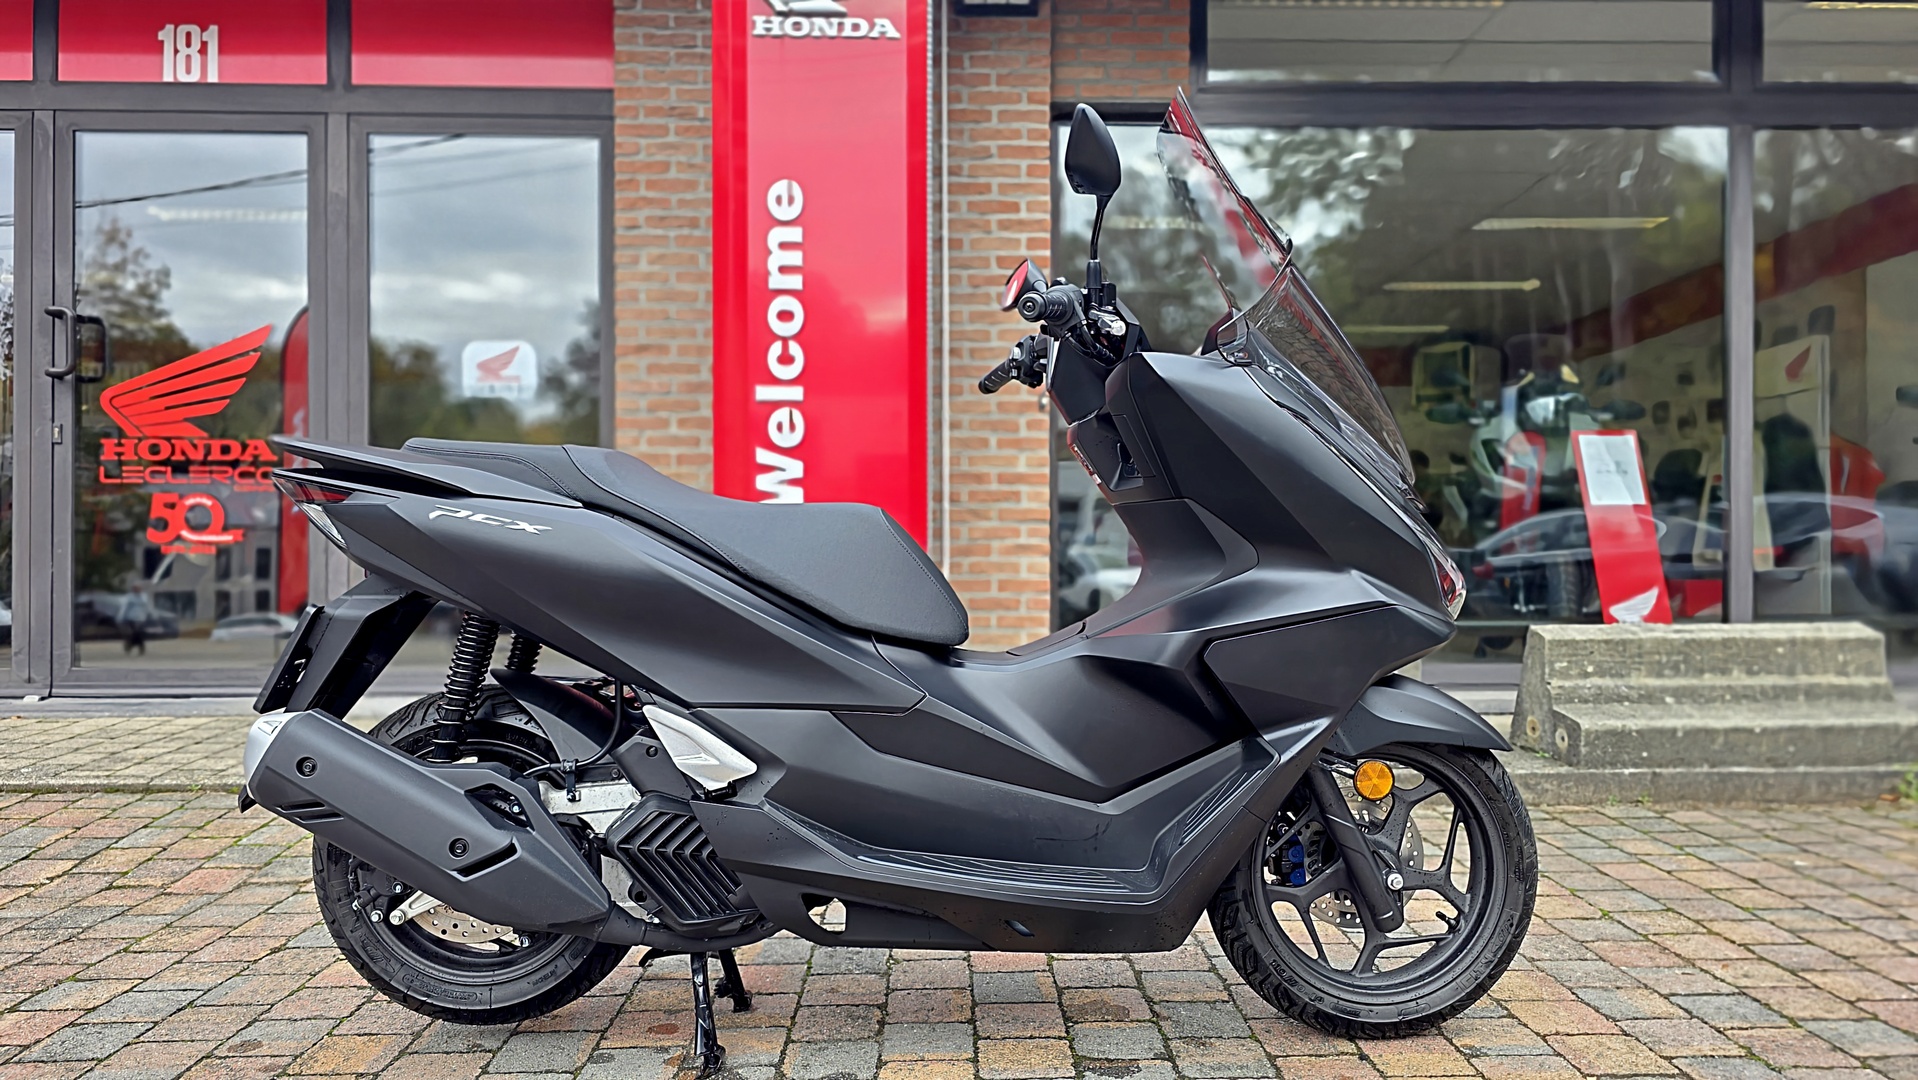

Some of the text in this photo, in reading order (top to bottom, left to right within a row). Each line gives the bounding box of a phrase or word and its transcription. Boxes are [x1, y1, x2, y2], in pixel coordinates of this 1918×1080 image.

[752, 15, 901, 39] HONDA
[157, 23, 219, 83] 181
[755, 178, 804, 504] Welcome
[100, 438, 278, 461] HONDA
[428, 504, 553, 535] PCX
